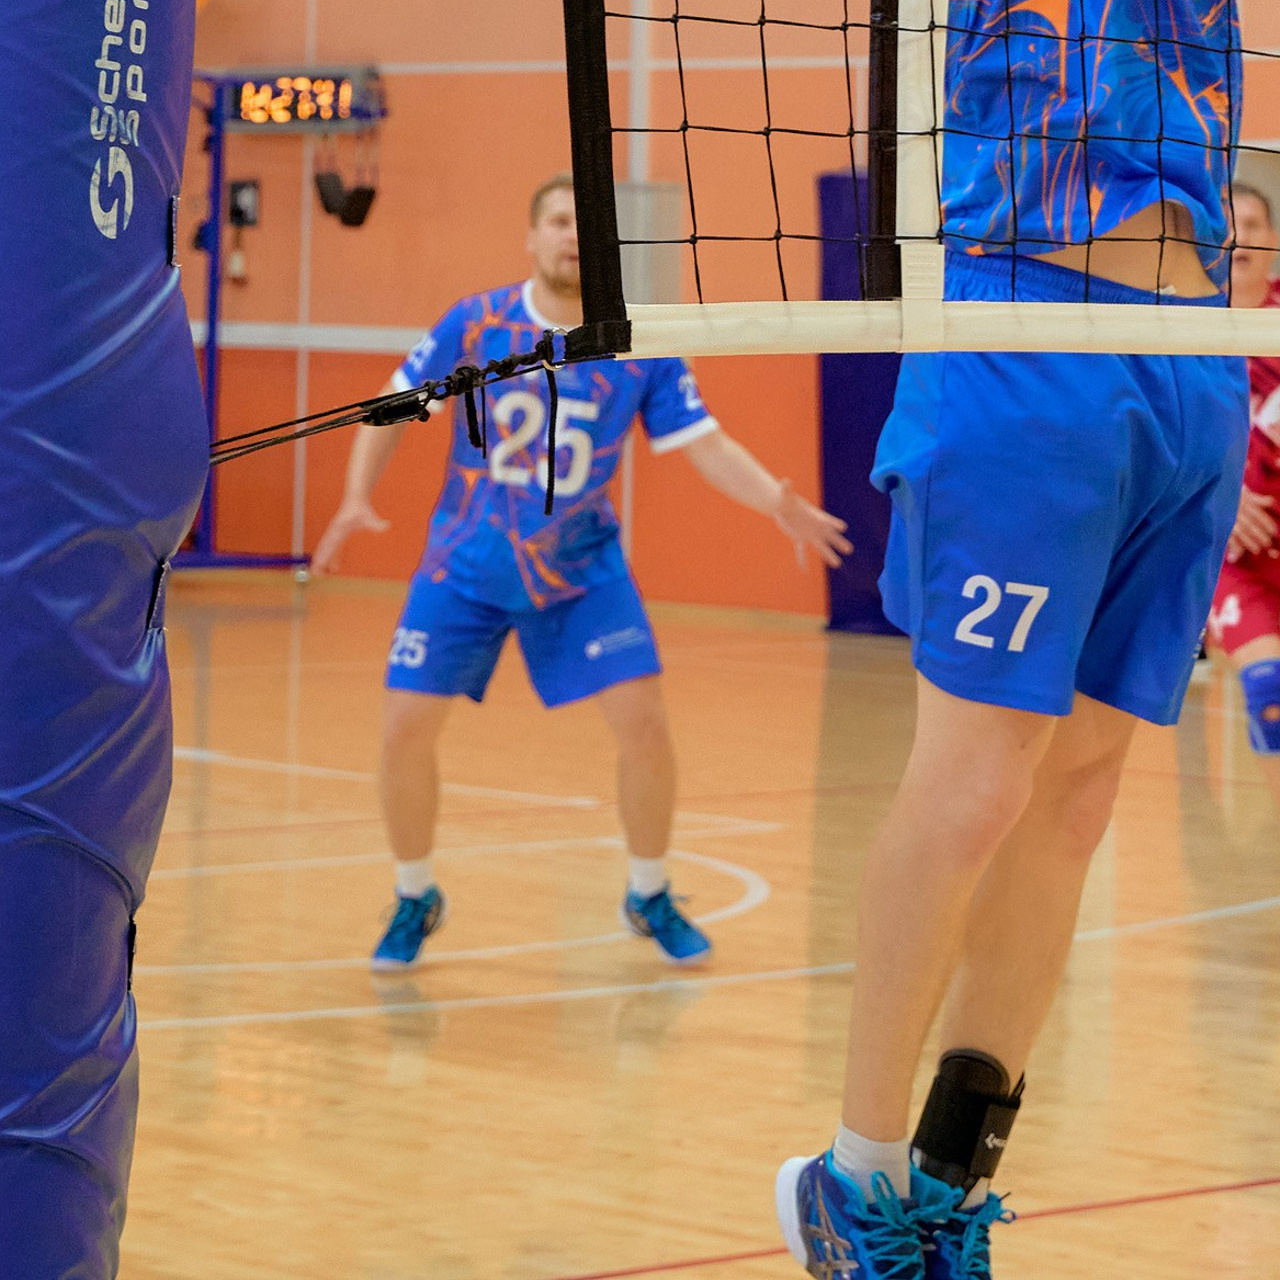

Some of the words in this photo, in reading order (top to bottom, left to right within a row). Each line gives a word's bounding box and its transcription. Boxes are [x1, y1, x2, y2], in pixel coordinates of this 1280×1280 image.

[490, 390, 600, 498] 25
[388, 626, 430, 670] 25
[954, 574, 1050, 652] 27
